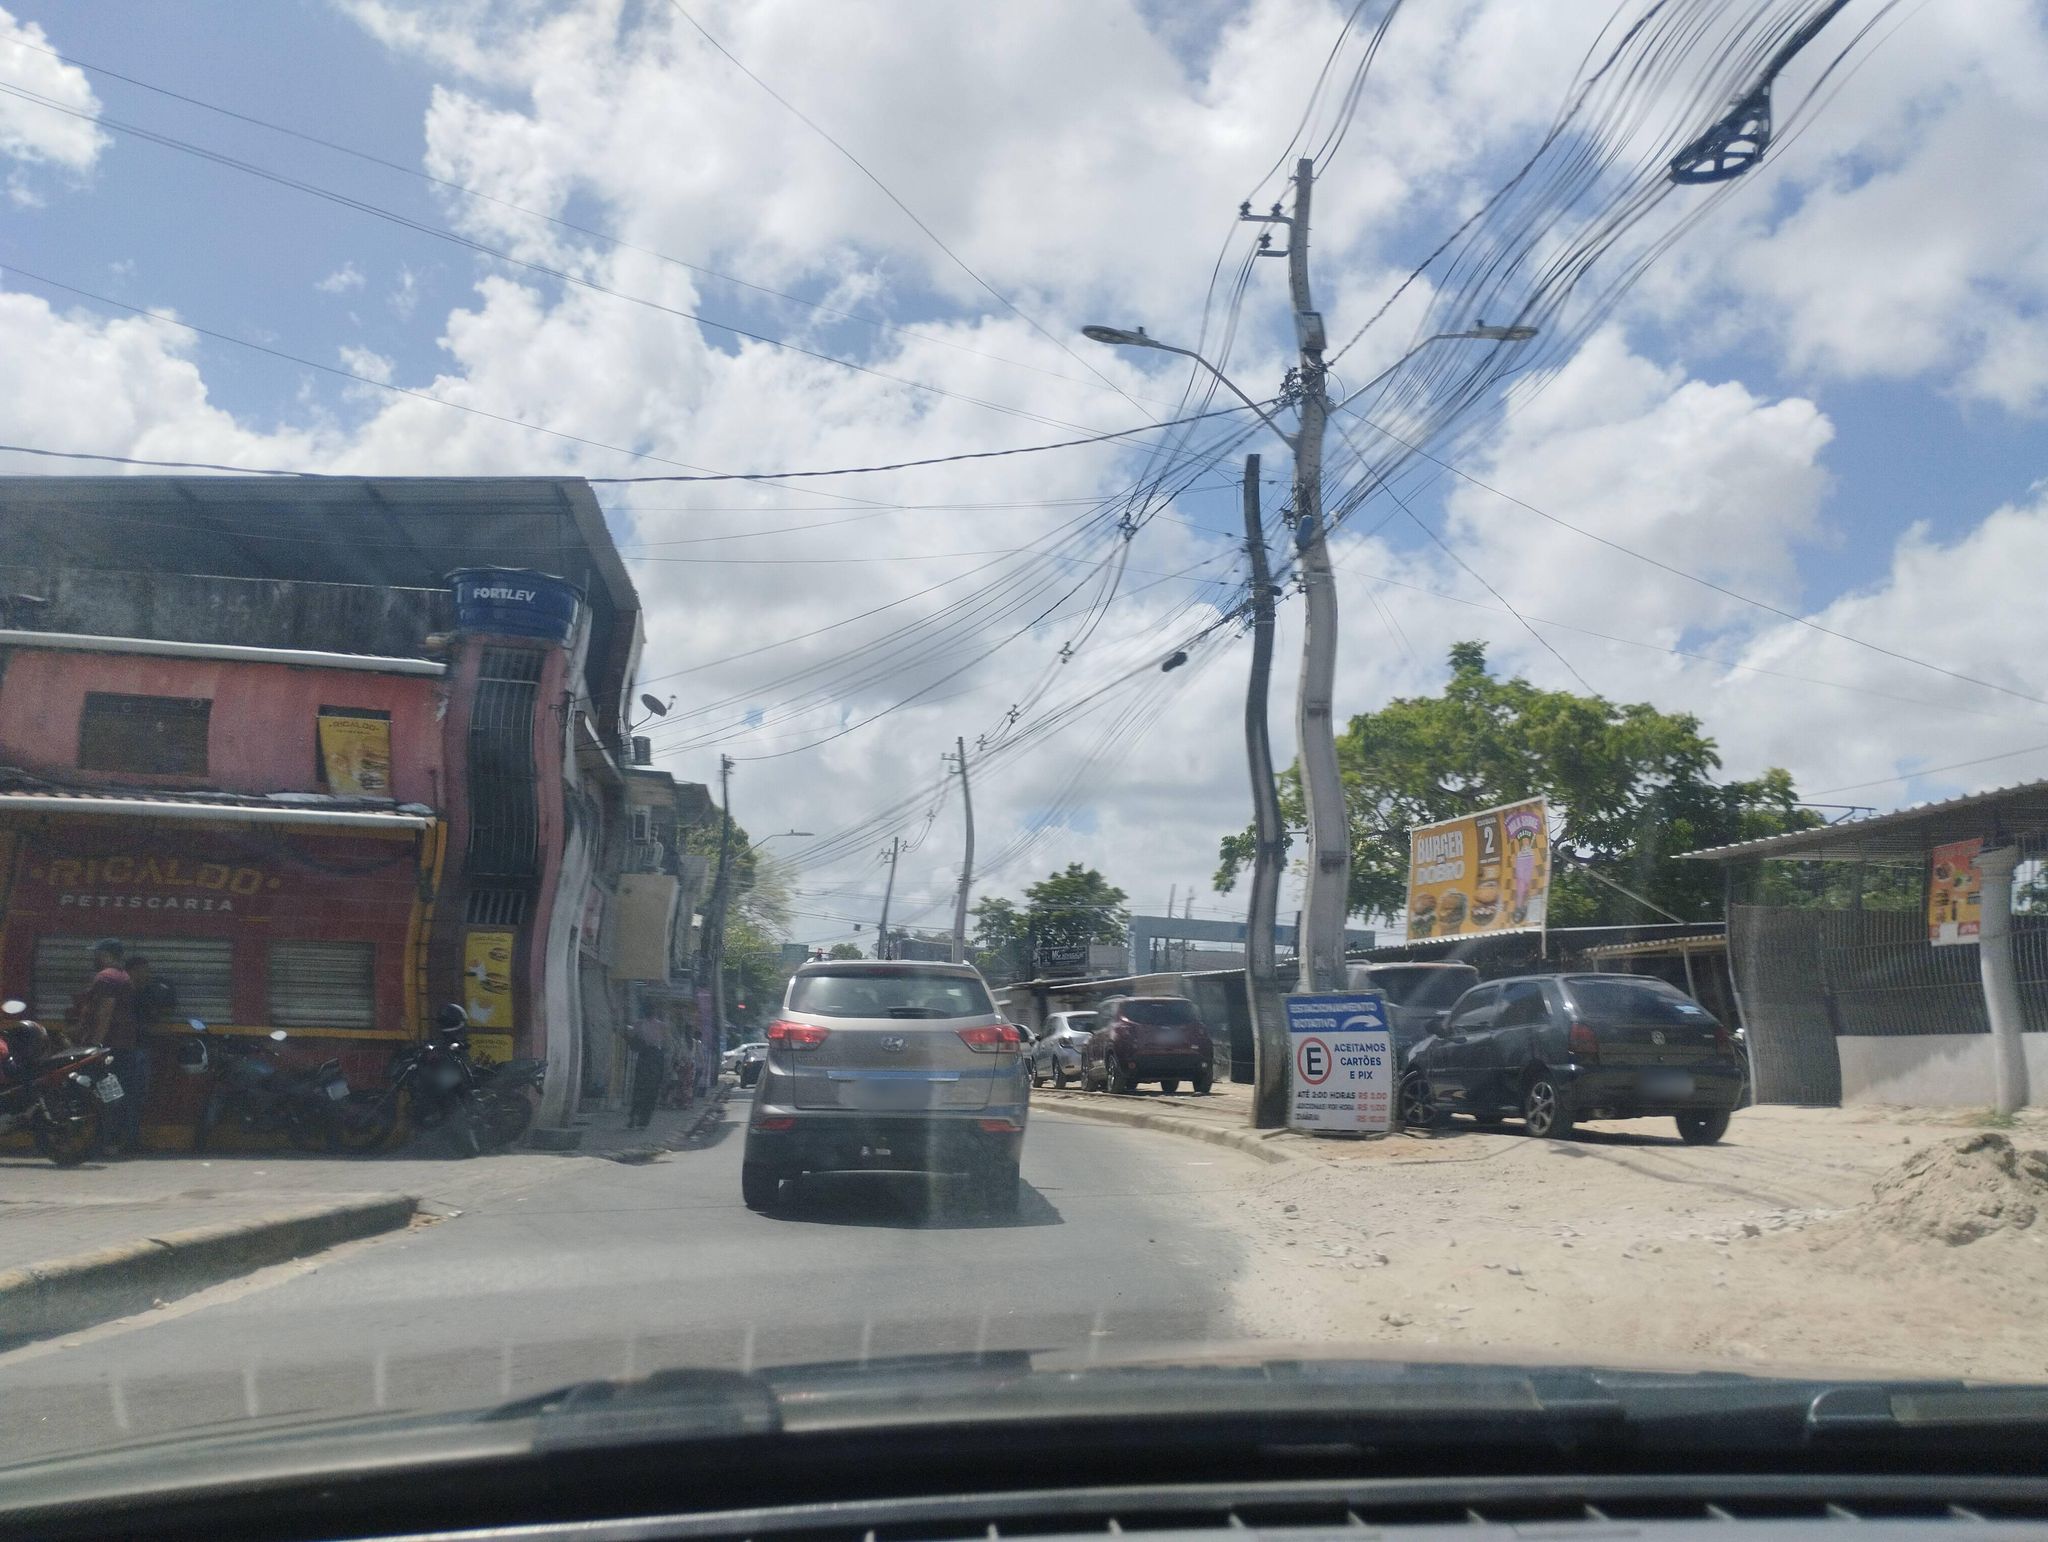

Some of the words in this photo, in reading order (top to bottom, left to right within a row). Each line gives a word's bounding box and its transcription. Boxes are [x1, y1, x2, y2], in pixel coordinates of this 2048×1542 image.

[473, 587, 537, 602] FORTLEV
[1483, 826, 1495, 854] 2
[1416, 831, 1464, 865] BURGER
[59, 893, 233, 912] PETISCARIA
[1334, 1043, 1387, 1053] ACEITAMOS
[1306, 1047, 1324, 1075] E
[1340, 1054, 1382, 1066] CARTÕES
[1350, 1070, 1356, 1080] E
[1358, 1070, 1374, 1080] PIX
[1297, 1090, 1310, 1099] ATÉ
